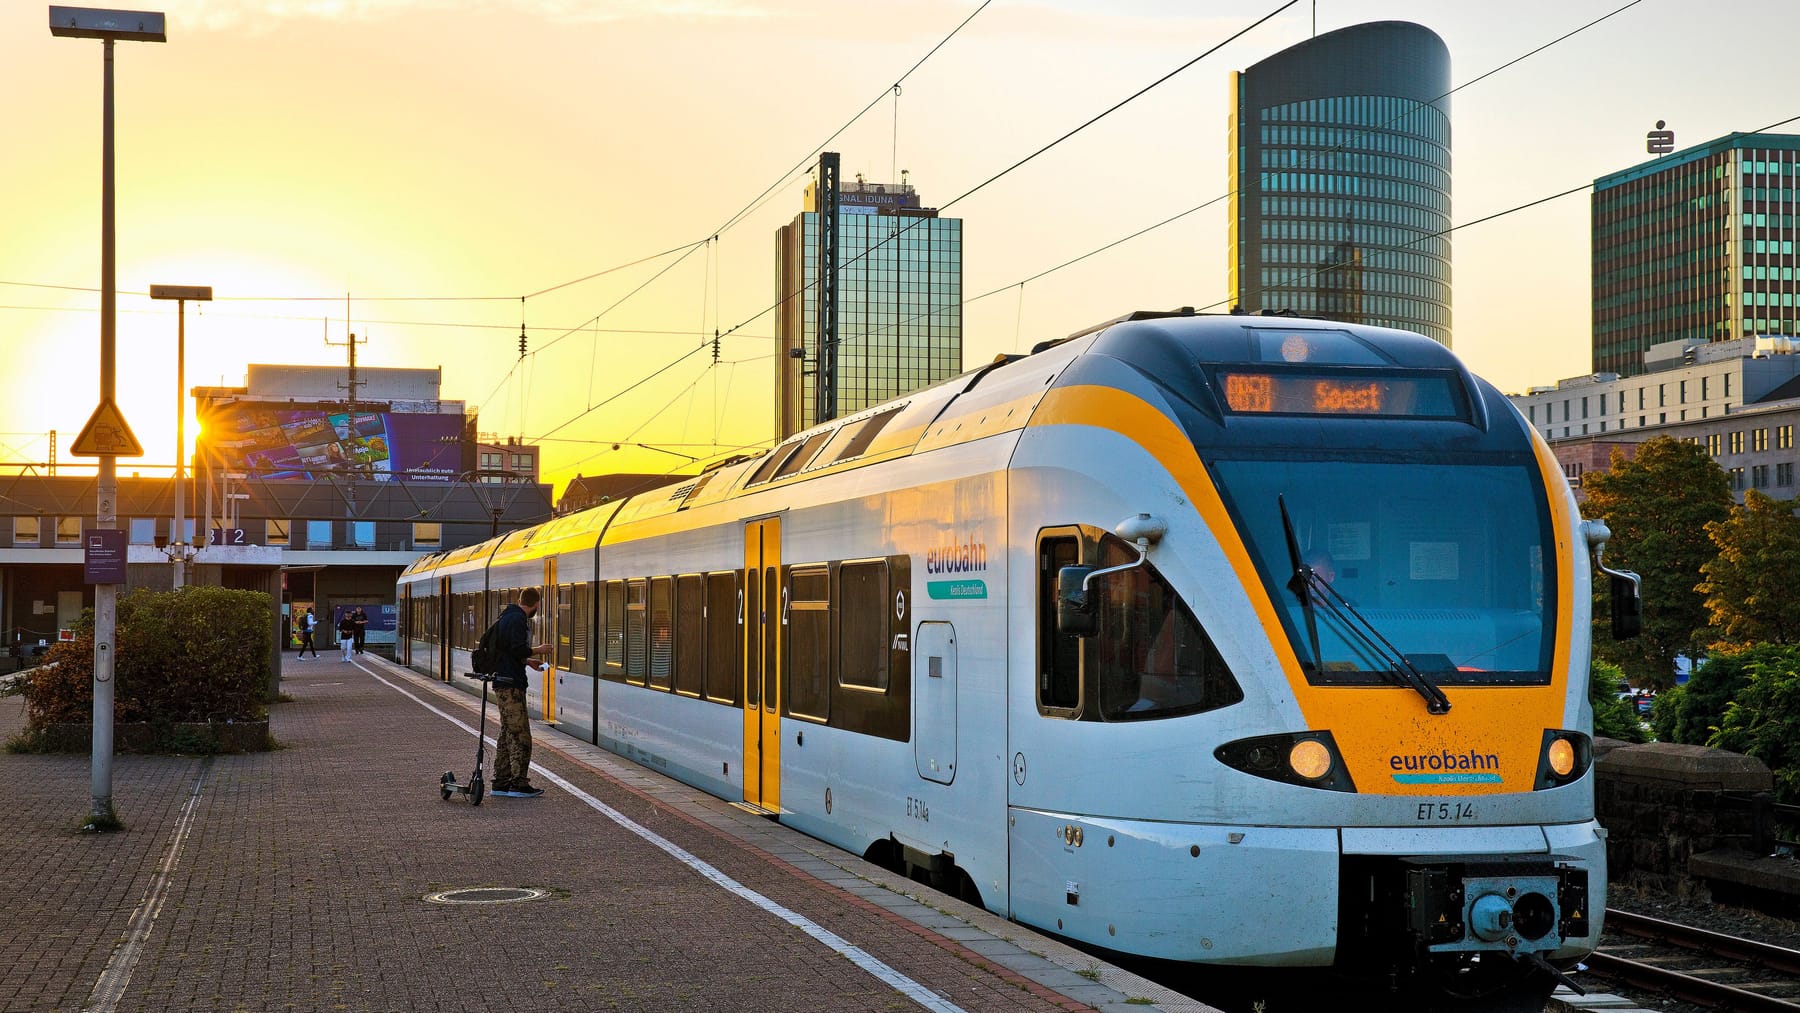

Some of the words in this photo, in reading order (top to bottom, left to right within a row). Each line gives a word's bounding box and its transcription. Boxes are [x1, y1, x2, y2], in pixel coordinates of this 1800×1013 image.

[865, 195, 894, 204] IDUNA
[1315, 380, 1381, 412] Soest
[234, 529, 244, 543] 2
[927, 535, 987, 574] eurobahn
[738, 588, 743, 625] 2
[782, 586, 788, 625] 2
[1389, 749, 1499, 770] eurobahn
[1418, 803, 1435, 820] ET
[1438, 803, 1473, 820] 5.14
